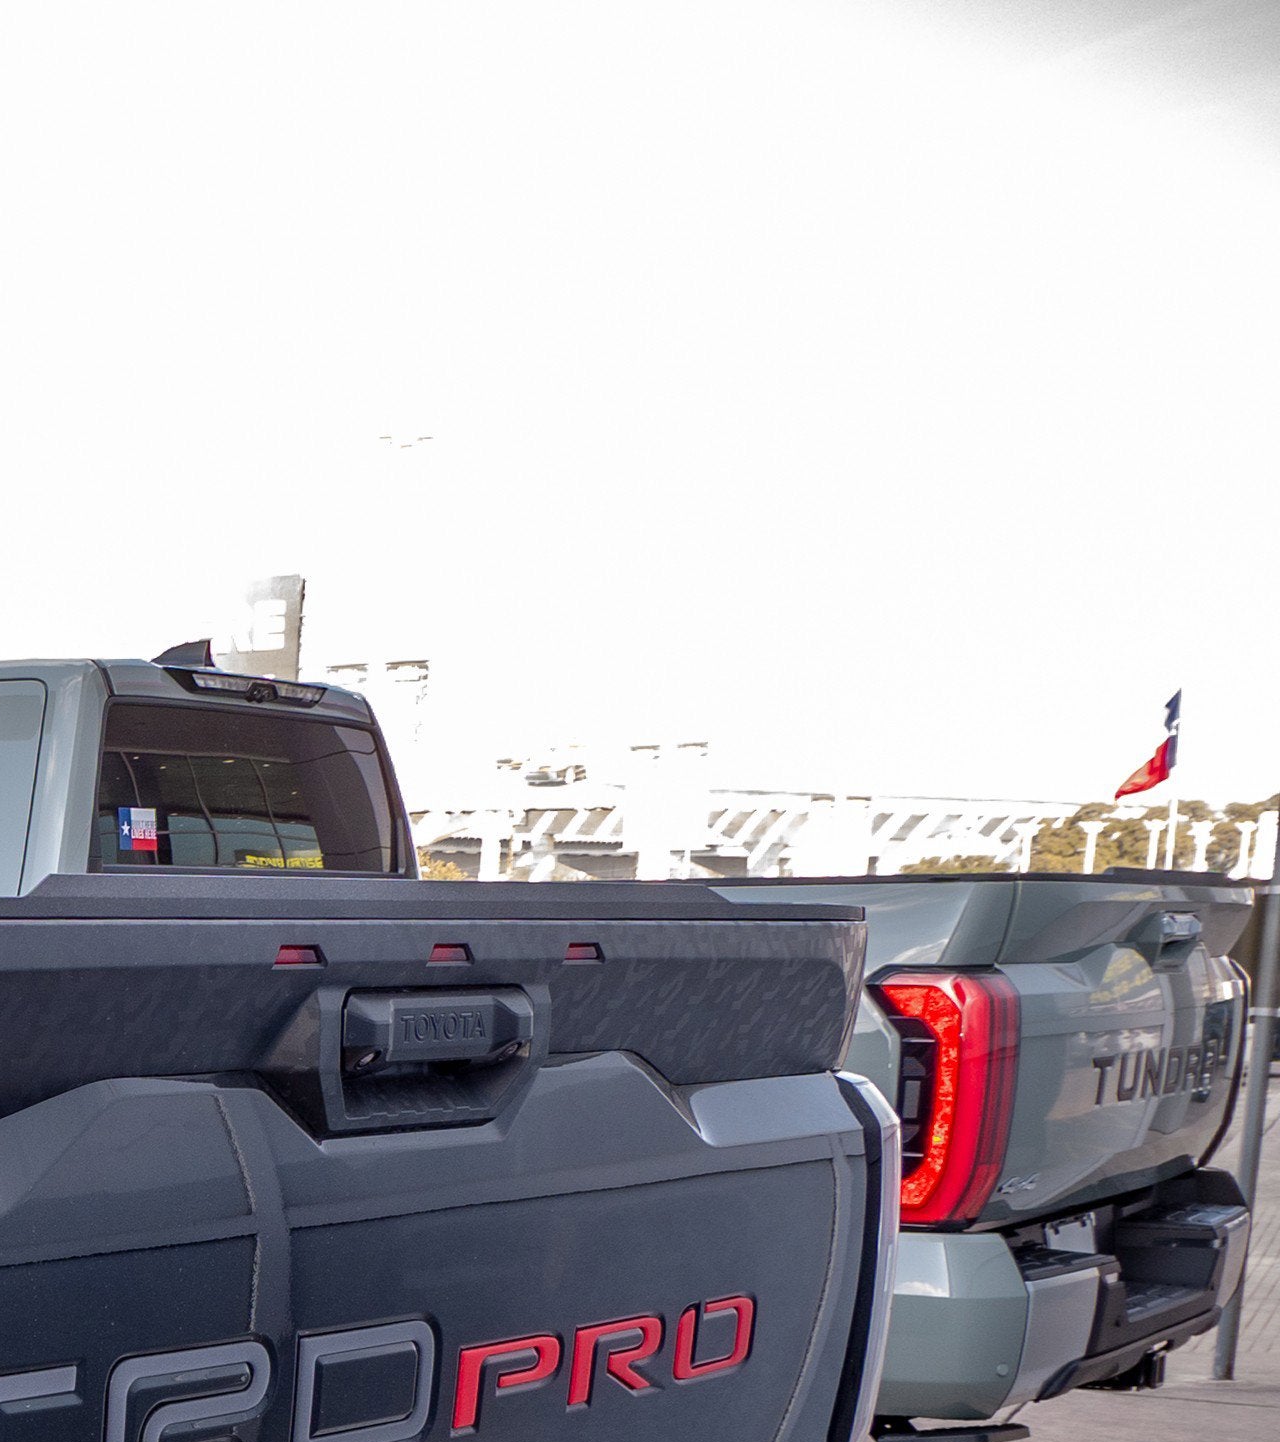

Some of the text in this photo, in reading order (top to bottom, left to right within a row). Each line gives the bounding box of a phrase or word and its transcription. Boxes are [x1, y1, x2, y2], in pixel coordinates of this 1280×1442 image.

[400, 1011, 487, 1044] TOYOTA
[1092, 1040, 1218, 1105] TUNDRA
[451, 1294, 755, 1436] PRO
